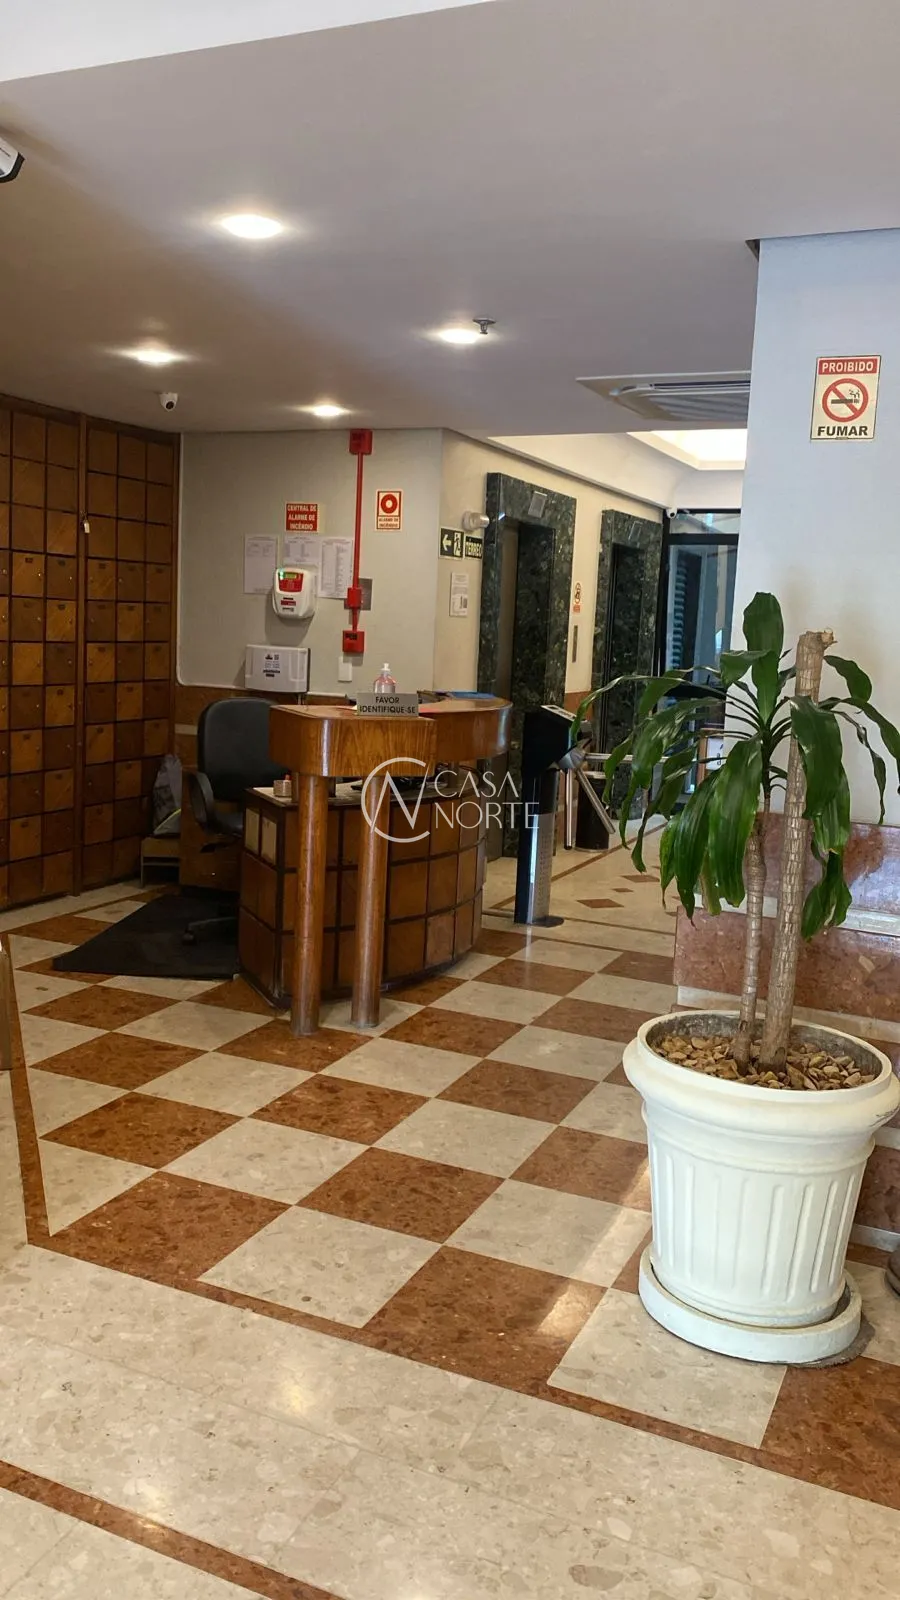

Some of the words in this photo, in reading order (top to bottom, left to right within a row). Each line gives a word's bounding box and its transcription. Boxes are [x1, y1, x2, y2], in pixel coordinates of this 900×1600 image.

[822, 361, 874, 373] PROIBIDO
[817, 425, 868, 437] FUMAR
[287, 503, 309, 511] CENTRAL
[375, 696, 400, 704] FAVOR
[359, 705, 416, 714] IDENTIFIQUE-SE
